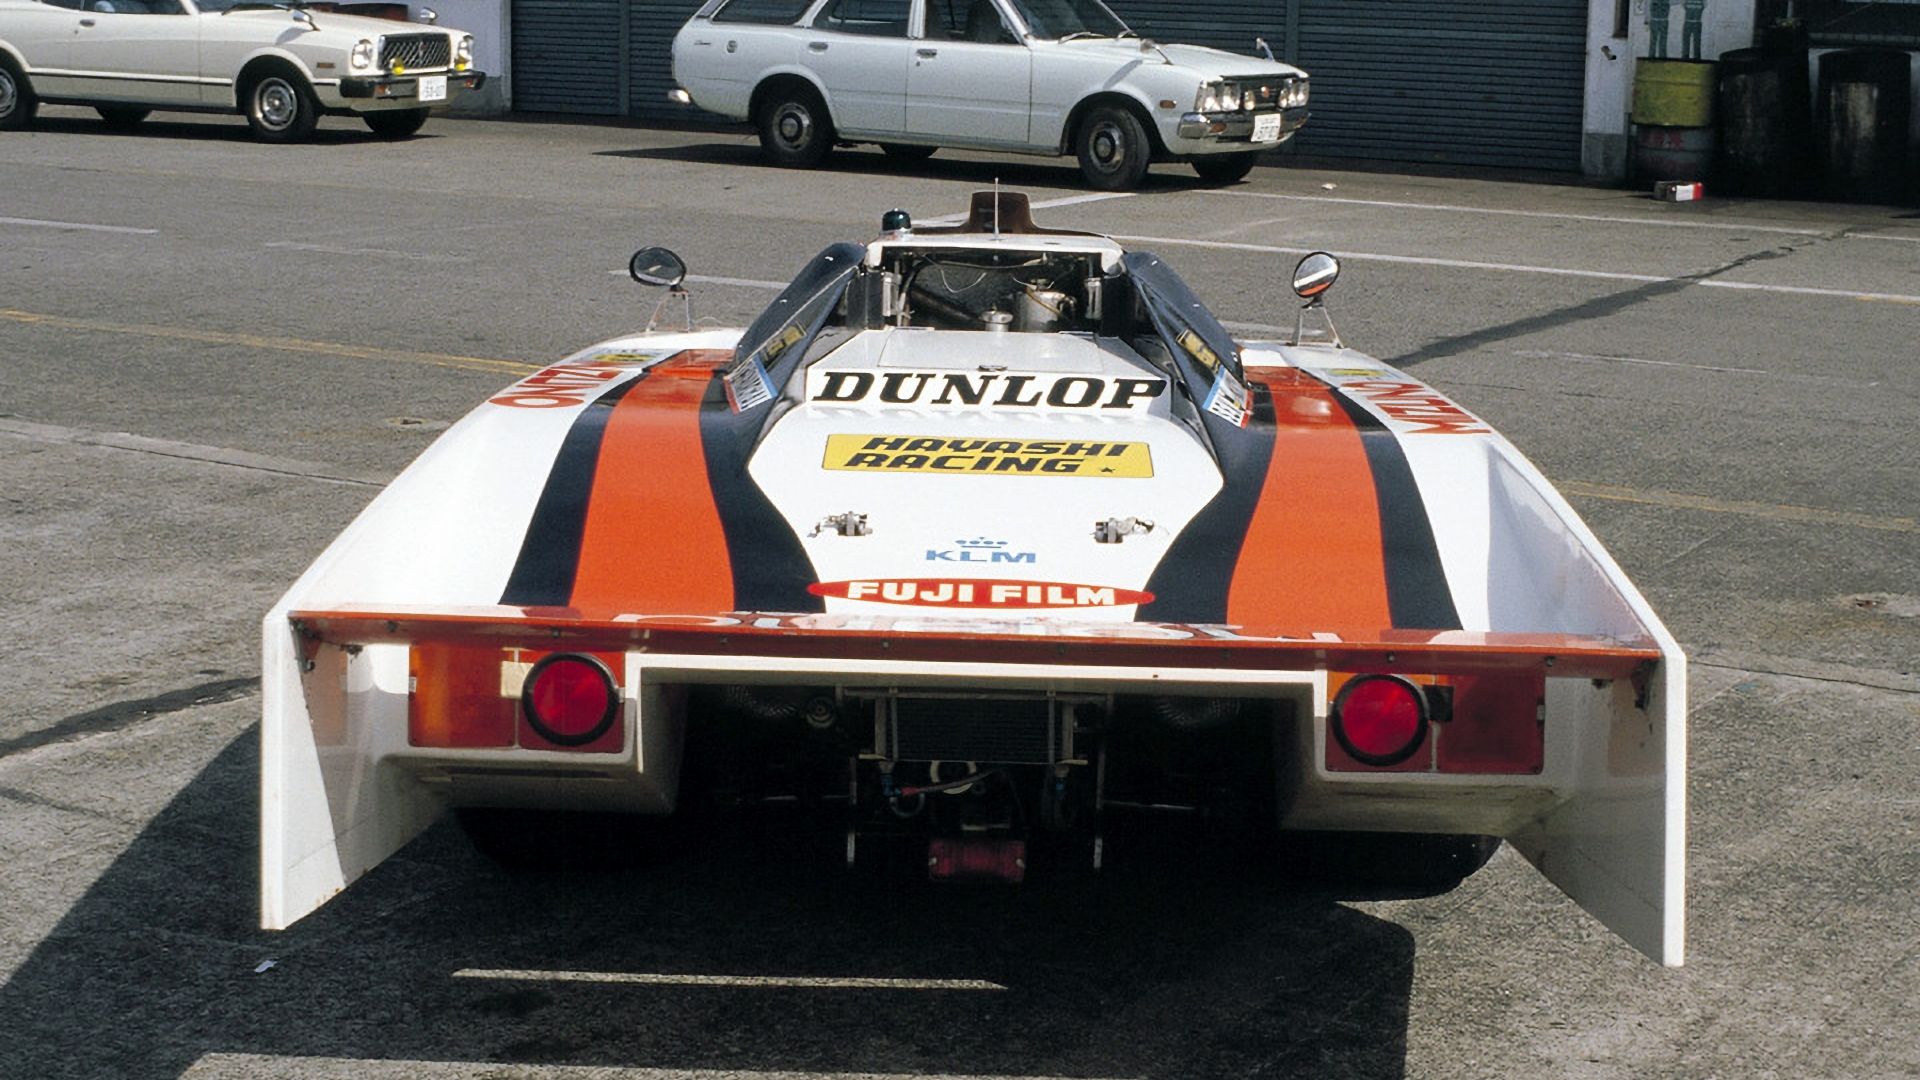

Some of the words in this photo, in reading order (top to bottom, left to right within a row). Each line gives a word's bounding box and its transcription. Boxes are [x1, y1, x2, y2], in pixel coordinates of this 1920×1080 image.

[812, 370, 1168, 410] DUNLOP
[1340, 381, 1491, 435] MIZUNO
[865, 436, 1129, 457] HAYASHI
[844, 452, 1084, 474] RACING
[925, 550, 1037, 564] KLM
[847, 580, 975, 603] FUJI
[990, 583, 1115, 606] FILM
